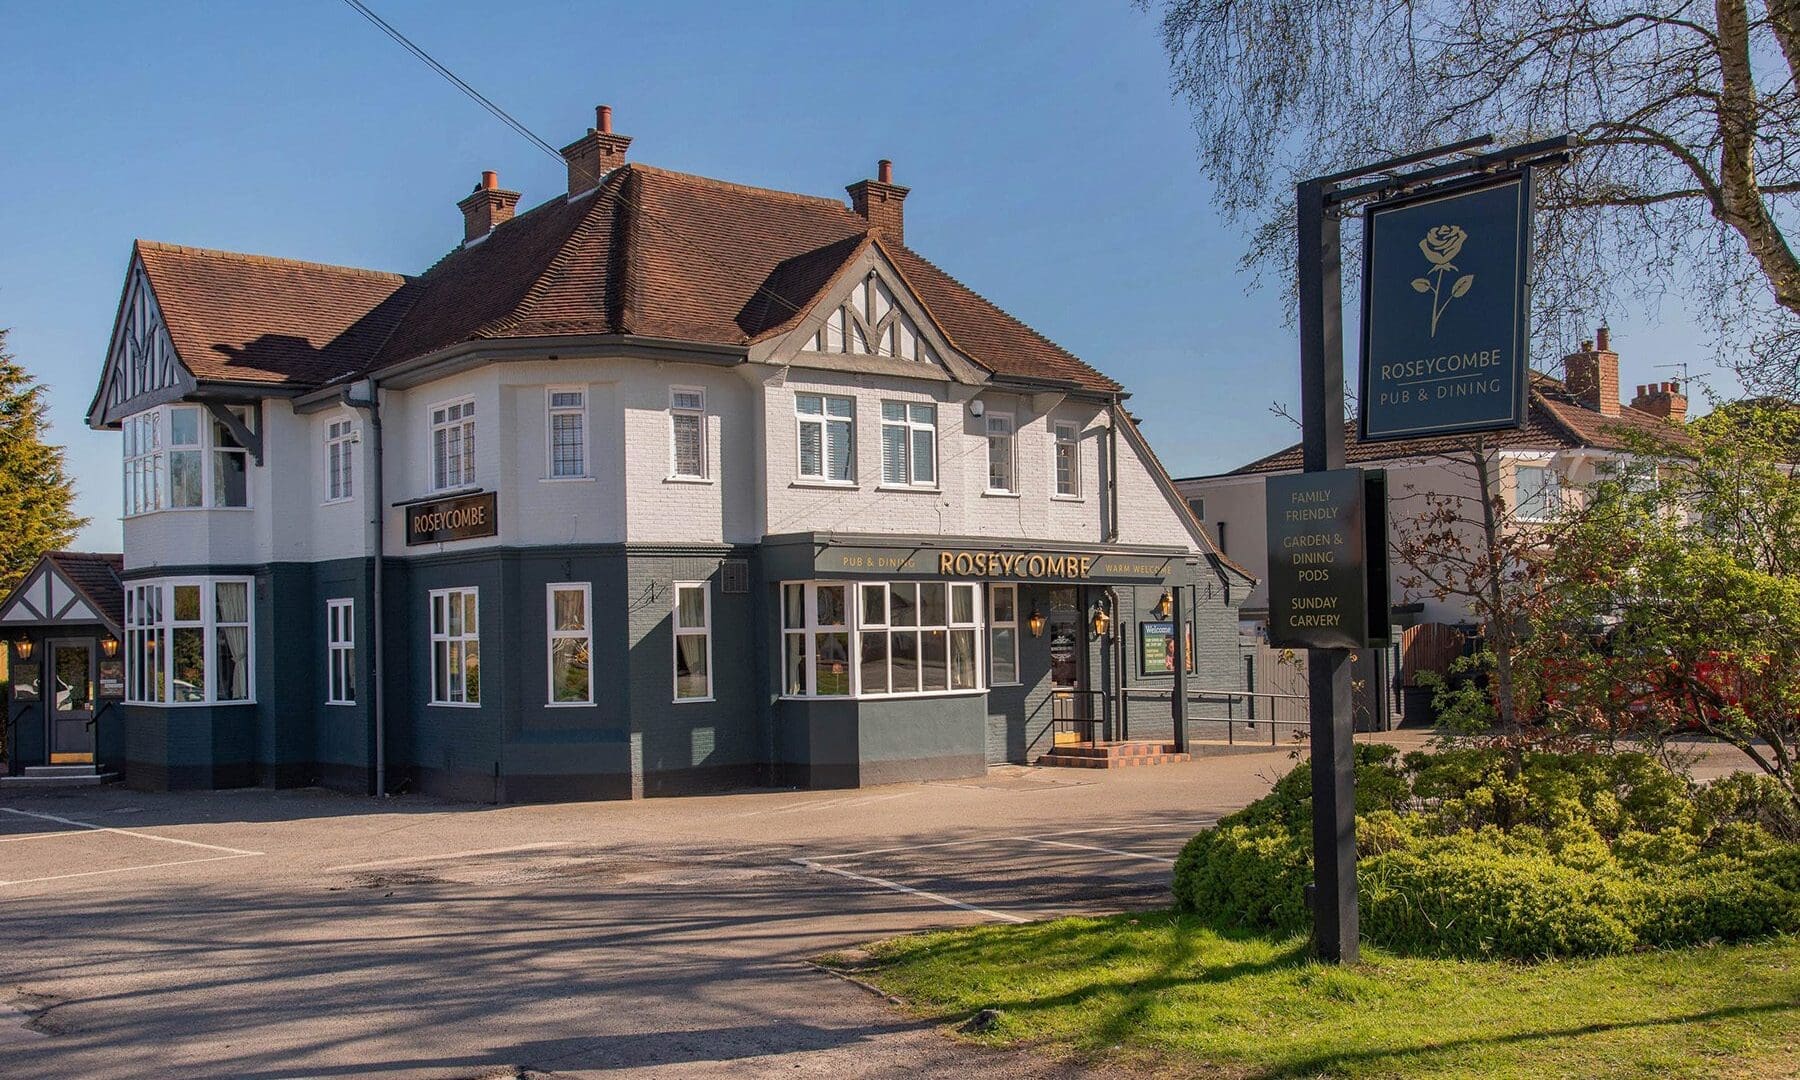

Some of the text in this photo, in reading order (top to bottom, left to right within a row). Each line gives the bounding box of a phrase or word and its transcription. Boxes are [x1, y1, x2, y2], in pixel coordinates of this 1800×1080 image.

[1381, 349, 1501, 380] ROSEYCOMBE
[1380, 379, 1500, 405] PUB & DINING
[1292, 490, 1331, 504] FAMILY
[414, 506, 485, 533] ROSEYCOMBE
[1286, 507, 1339, 521] FRIENDLY
[1283, 533, 1344, 548] GARDEN &
[843, 556, 916, 568] PUB & DINING
[940, 551, 1090, 578] ROSEYCOMBE
[1293, 552, 1334, 565] DINING
[1105, 563, 1172, 575] WARM WELCOME
[1298, 569, 1329, 582] PODS
[1291, 597, 1338, 609] SUNDAY
[1290, 614, 1341, 627] CARVERY
[1145, 624, 1172, 634] Welcome
